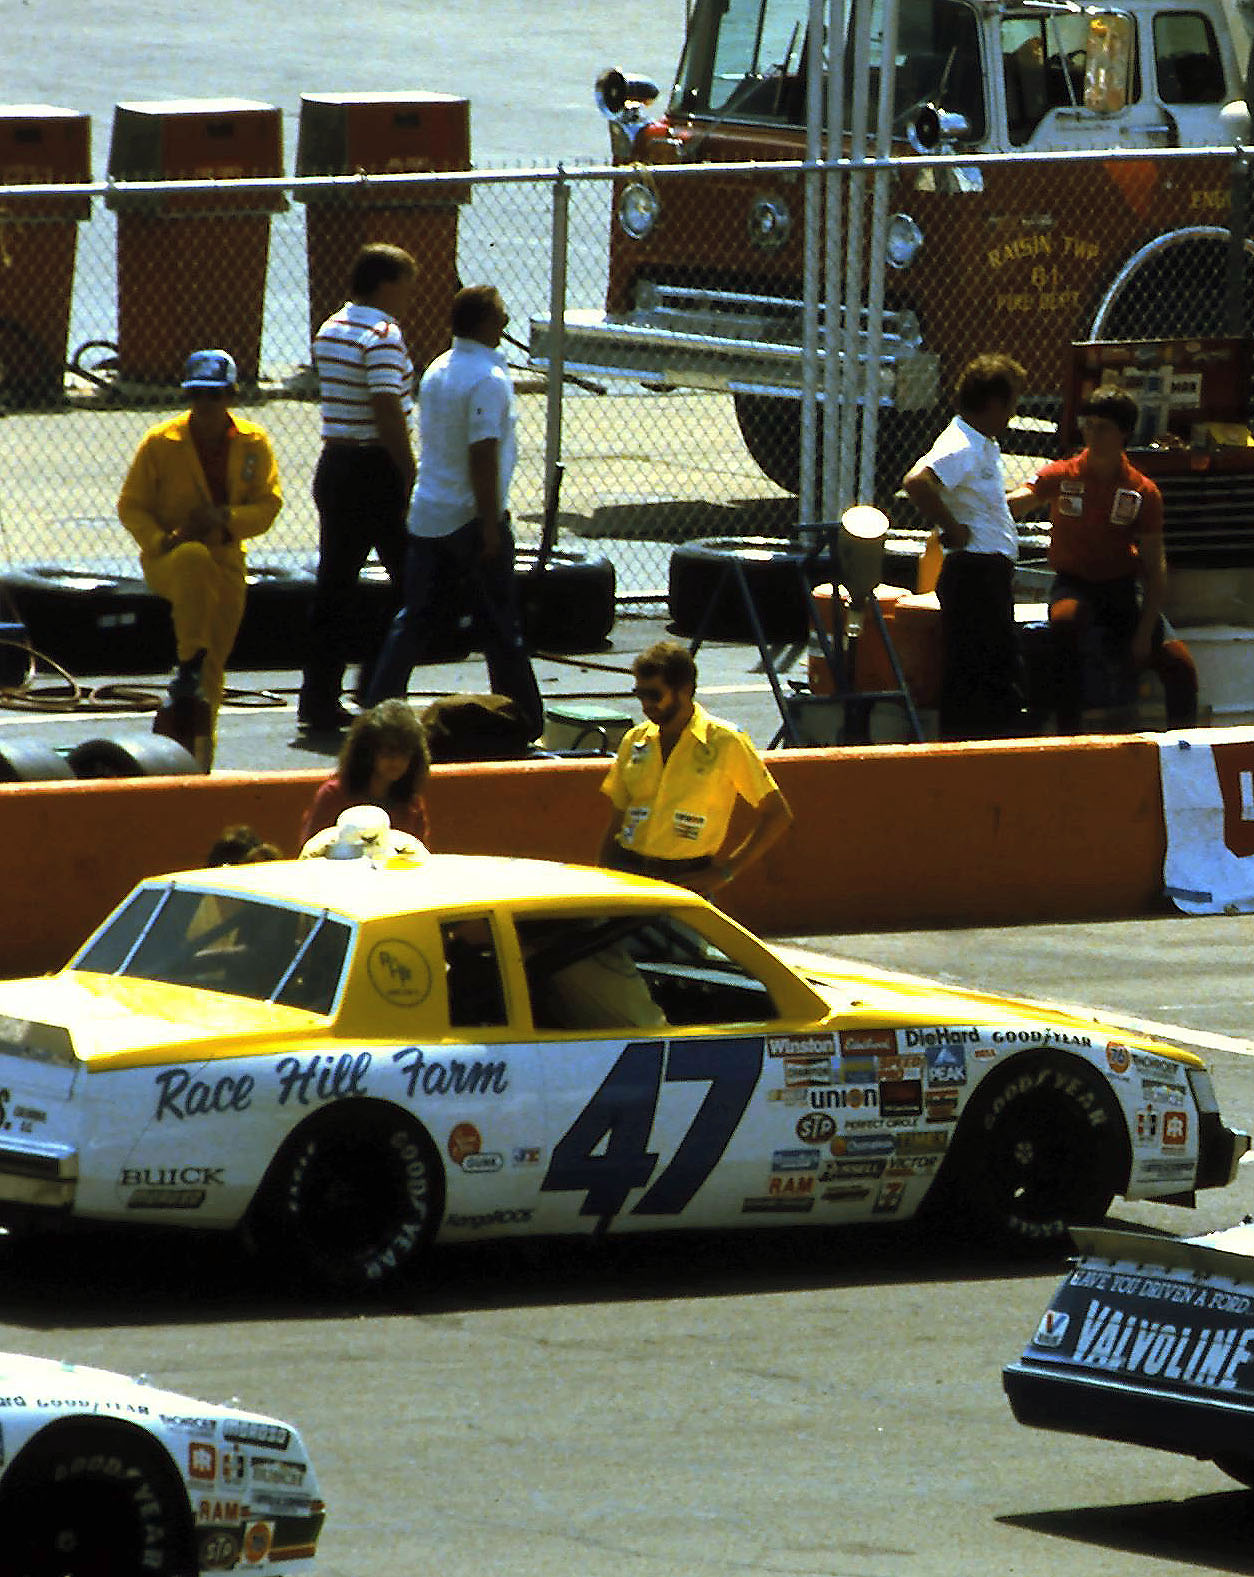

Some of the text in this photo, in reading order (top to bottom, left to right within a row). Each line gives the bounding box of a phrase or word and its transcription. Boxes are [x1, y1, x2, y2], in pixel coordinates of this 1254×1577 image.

[988, 234, 1052, 268] RAISIN
[767, 1038, 833, 1054] Winston
[905, 1027, 979, 1047] DieHard
[992, 1028, 1091, 1048] GOODYEAR
[155, 1046, 508, 1122] Race Hill Farm
[929, 1067, 966, 1082] PEAK
[811, 1088, 877, 1110] union
[540, 1037, 766, 1217] 47
[799, 1113, 833, 1139] STP
[120, 1167, 226, 1186] BUICK
[769, 1177, 815, 1195] RAM
[199, 1501, 239, 1520] RAM
